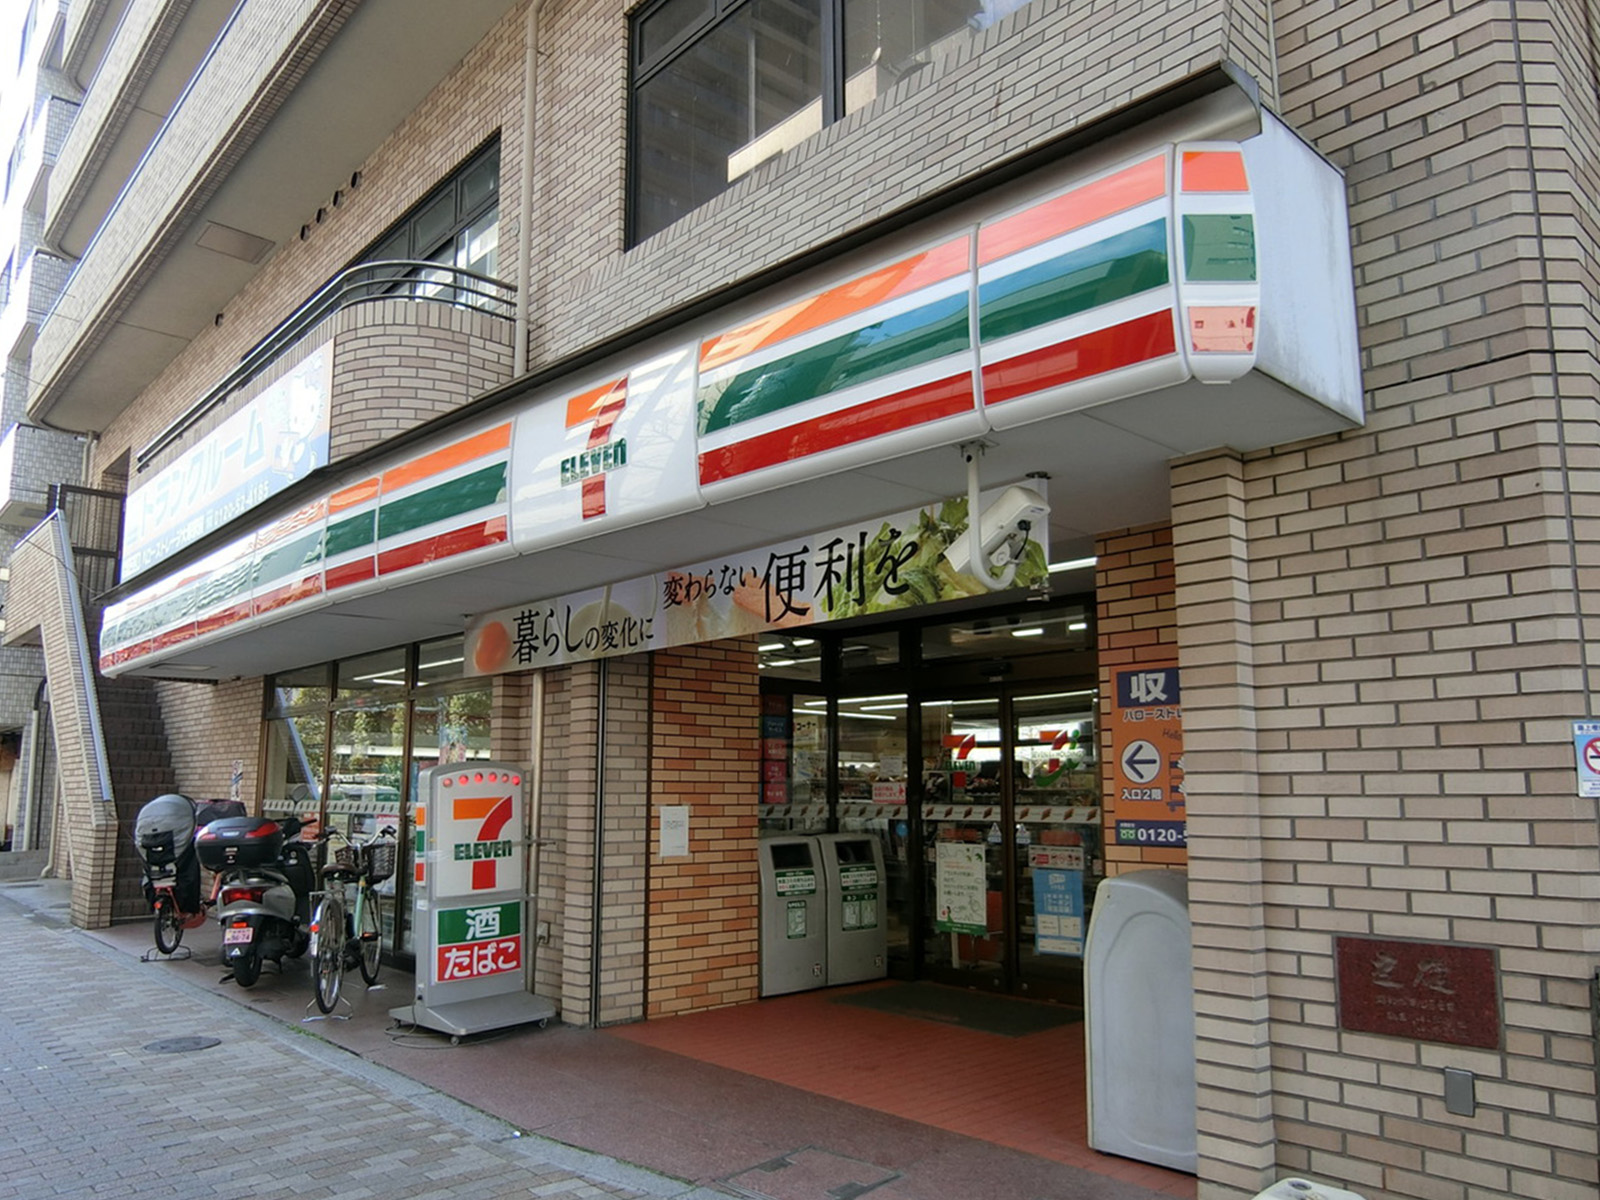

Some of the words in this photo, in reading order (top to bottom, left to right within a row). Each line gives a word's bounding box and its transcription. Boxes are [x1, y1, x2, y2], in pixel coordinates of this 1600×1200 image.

[141, 405, 266, 538] トランクルーム
[560, 438, 627, 487] ELEVEN
[662, 527, 919, 624] 変わらない便利を
[511, 607, 655, 665] 暮らしの変化に
[1129, 672, 1169, 703] 収
[454, 840, 512, 861] ELEVEN
[465, 908, 501, 941] 酒
[444, 942, 517, 979] たばこ
